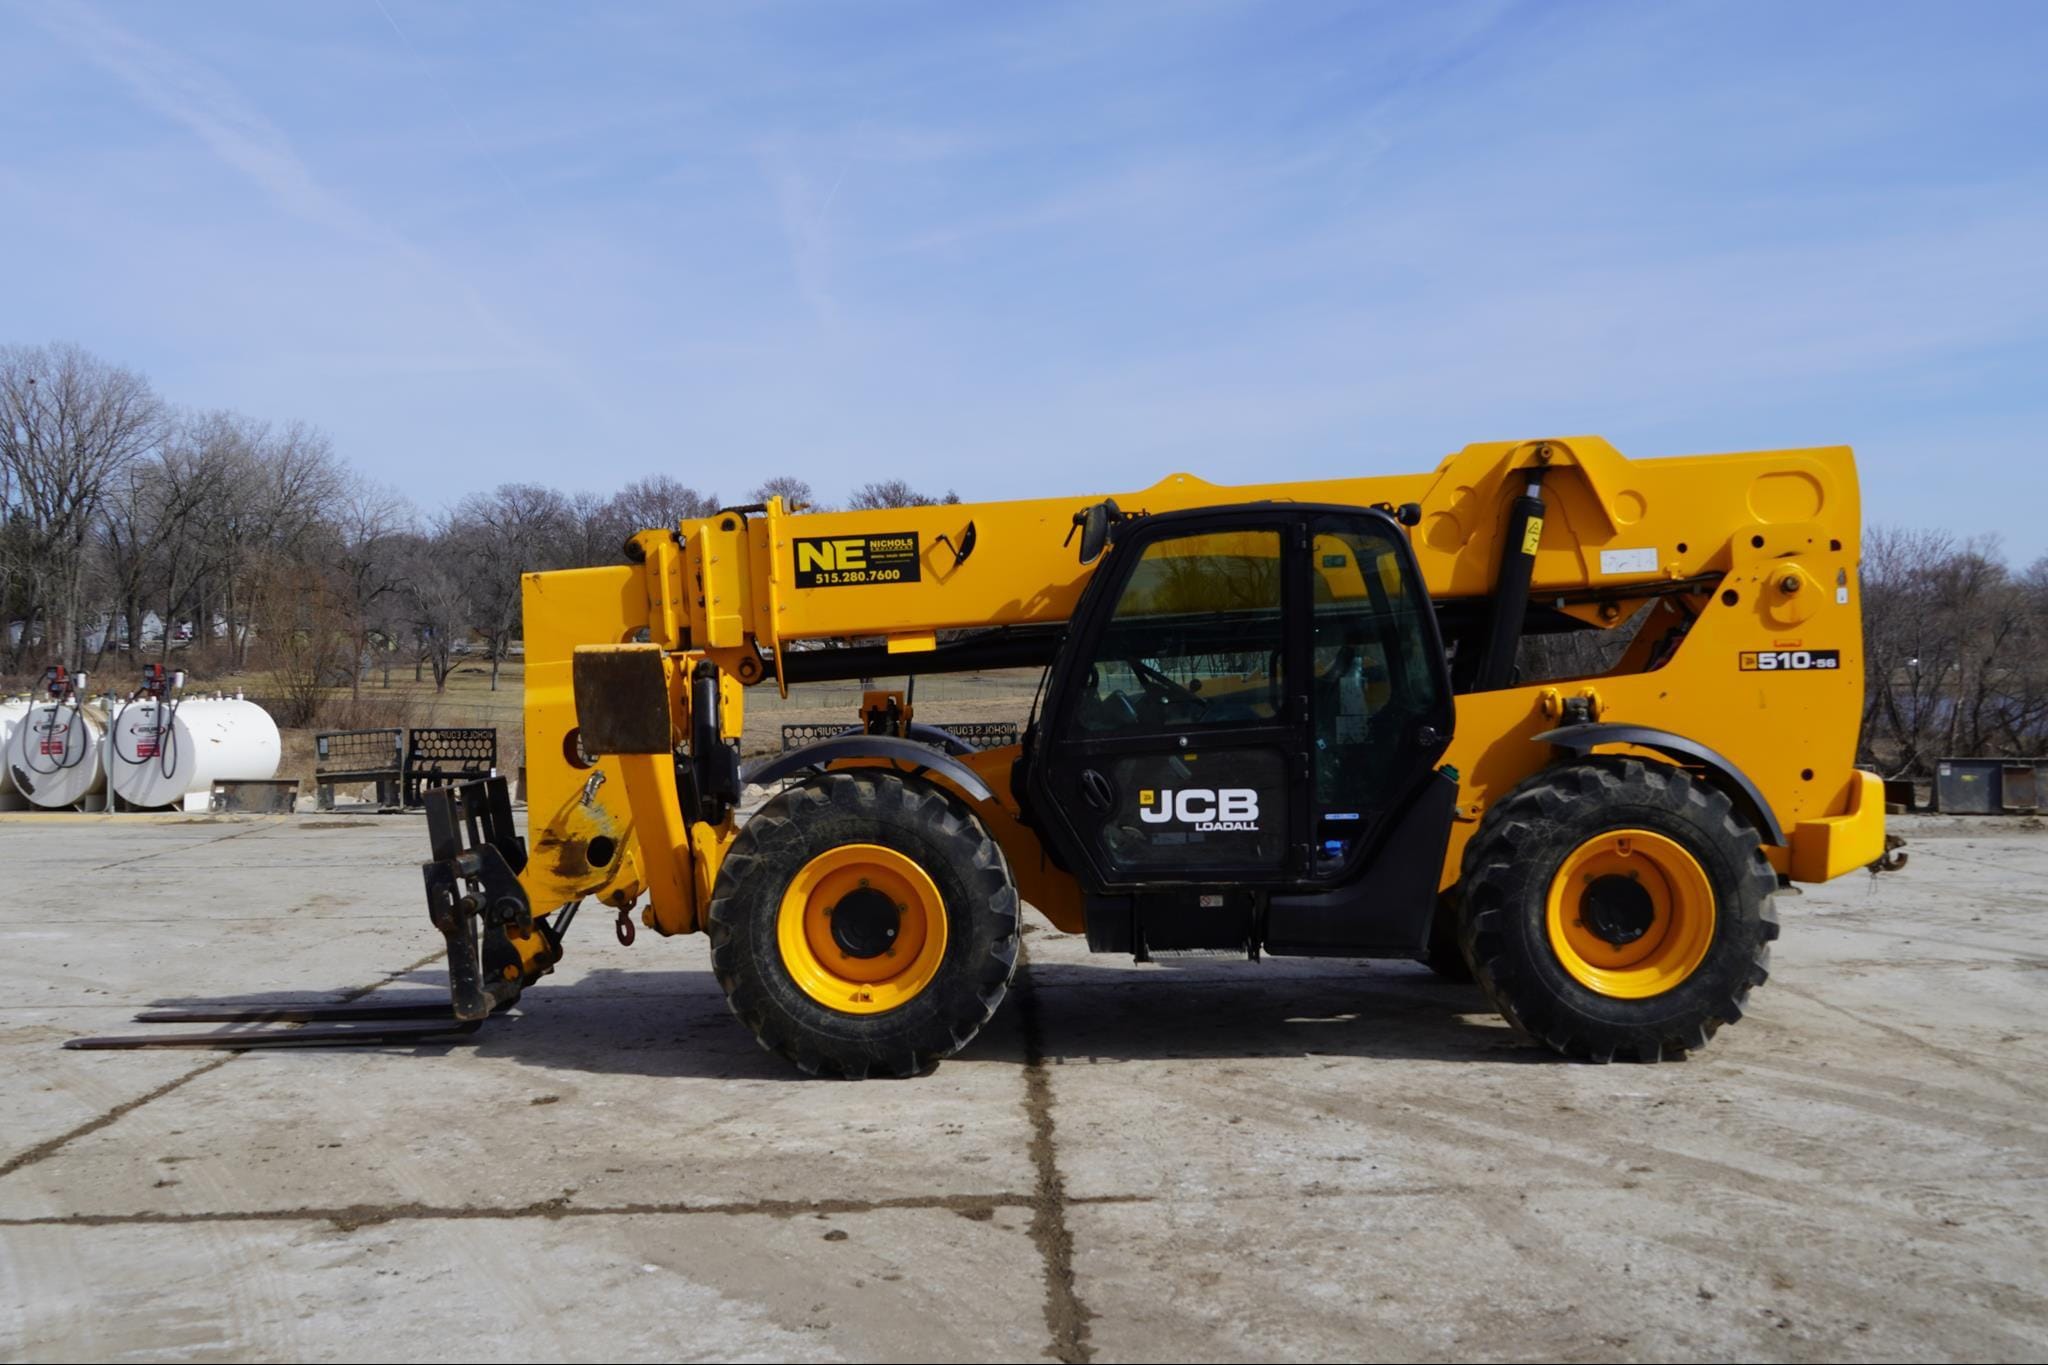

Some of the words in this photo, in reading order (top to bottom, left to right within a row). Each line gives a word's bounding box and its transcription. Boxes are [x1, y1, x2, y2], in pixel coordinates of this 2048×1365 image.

[869, 538, 913, 549] NICHOLS
[798, 539, 867, 572] NE
[816, 570, 900, 583] 515.280.7600
[1140, 788, 1260, 824] JCB
[1195, 821, 1259, 832] LOADALL
